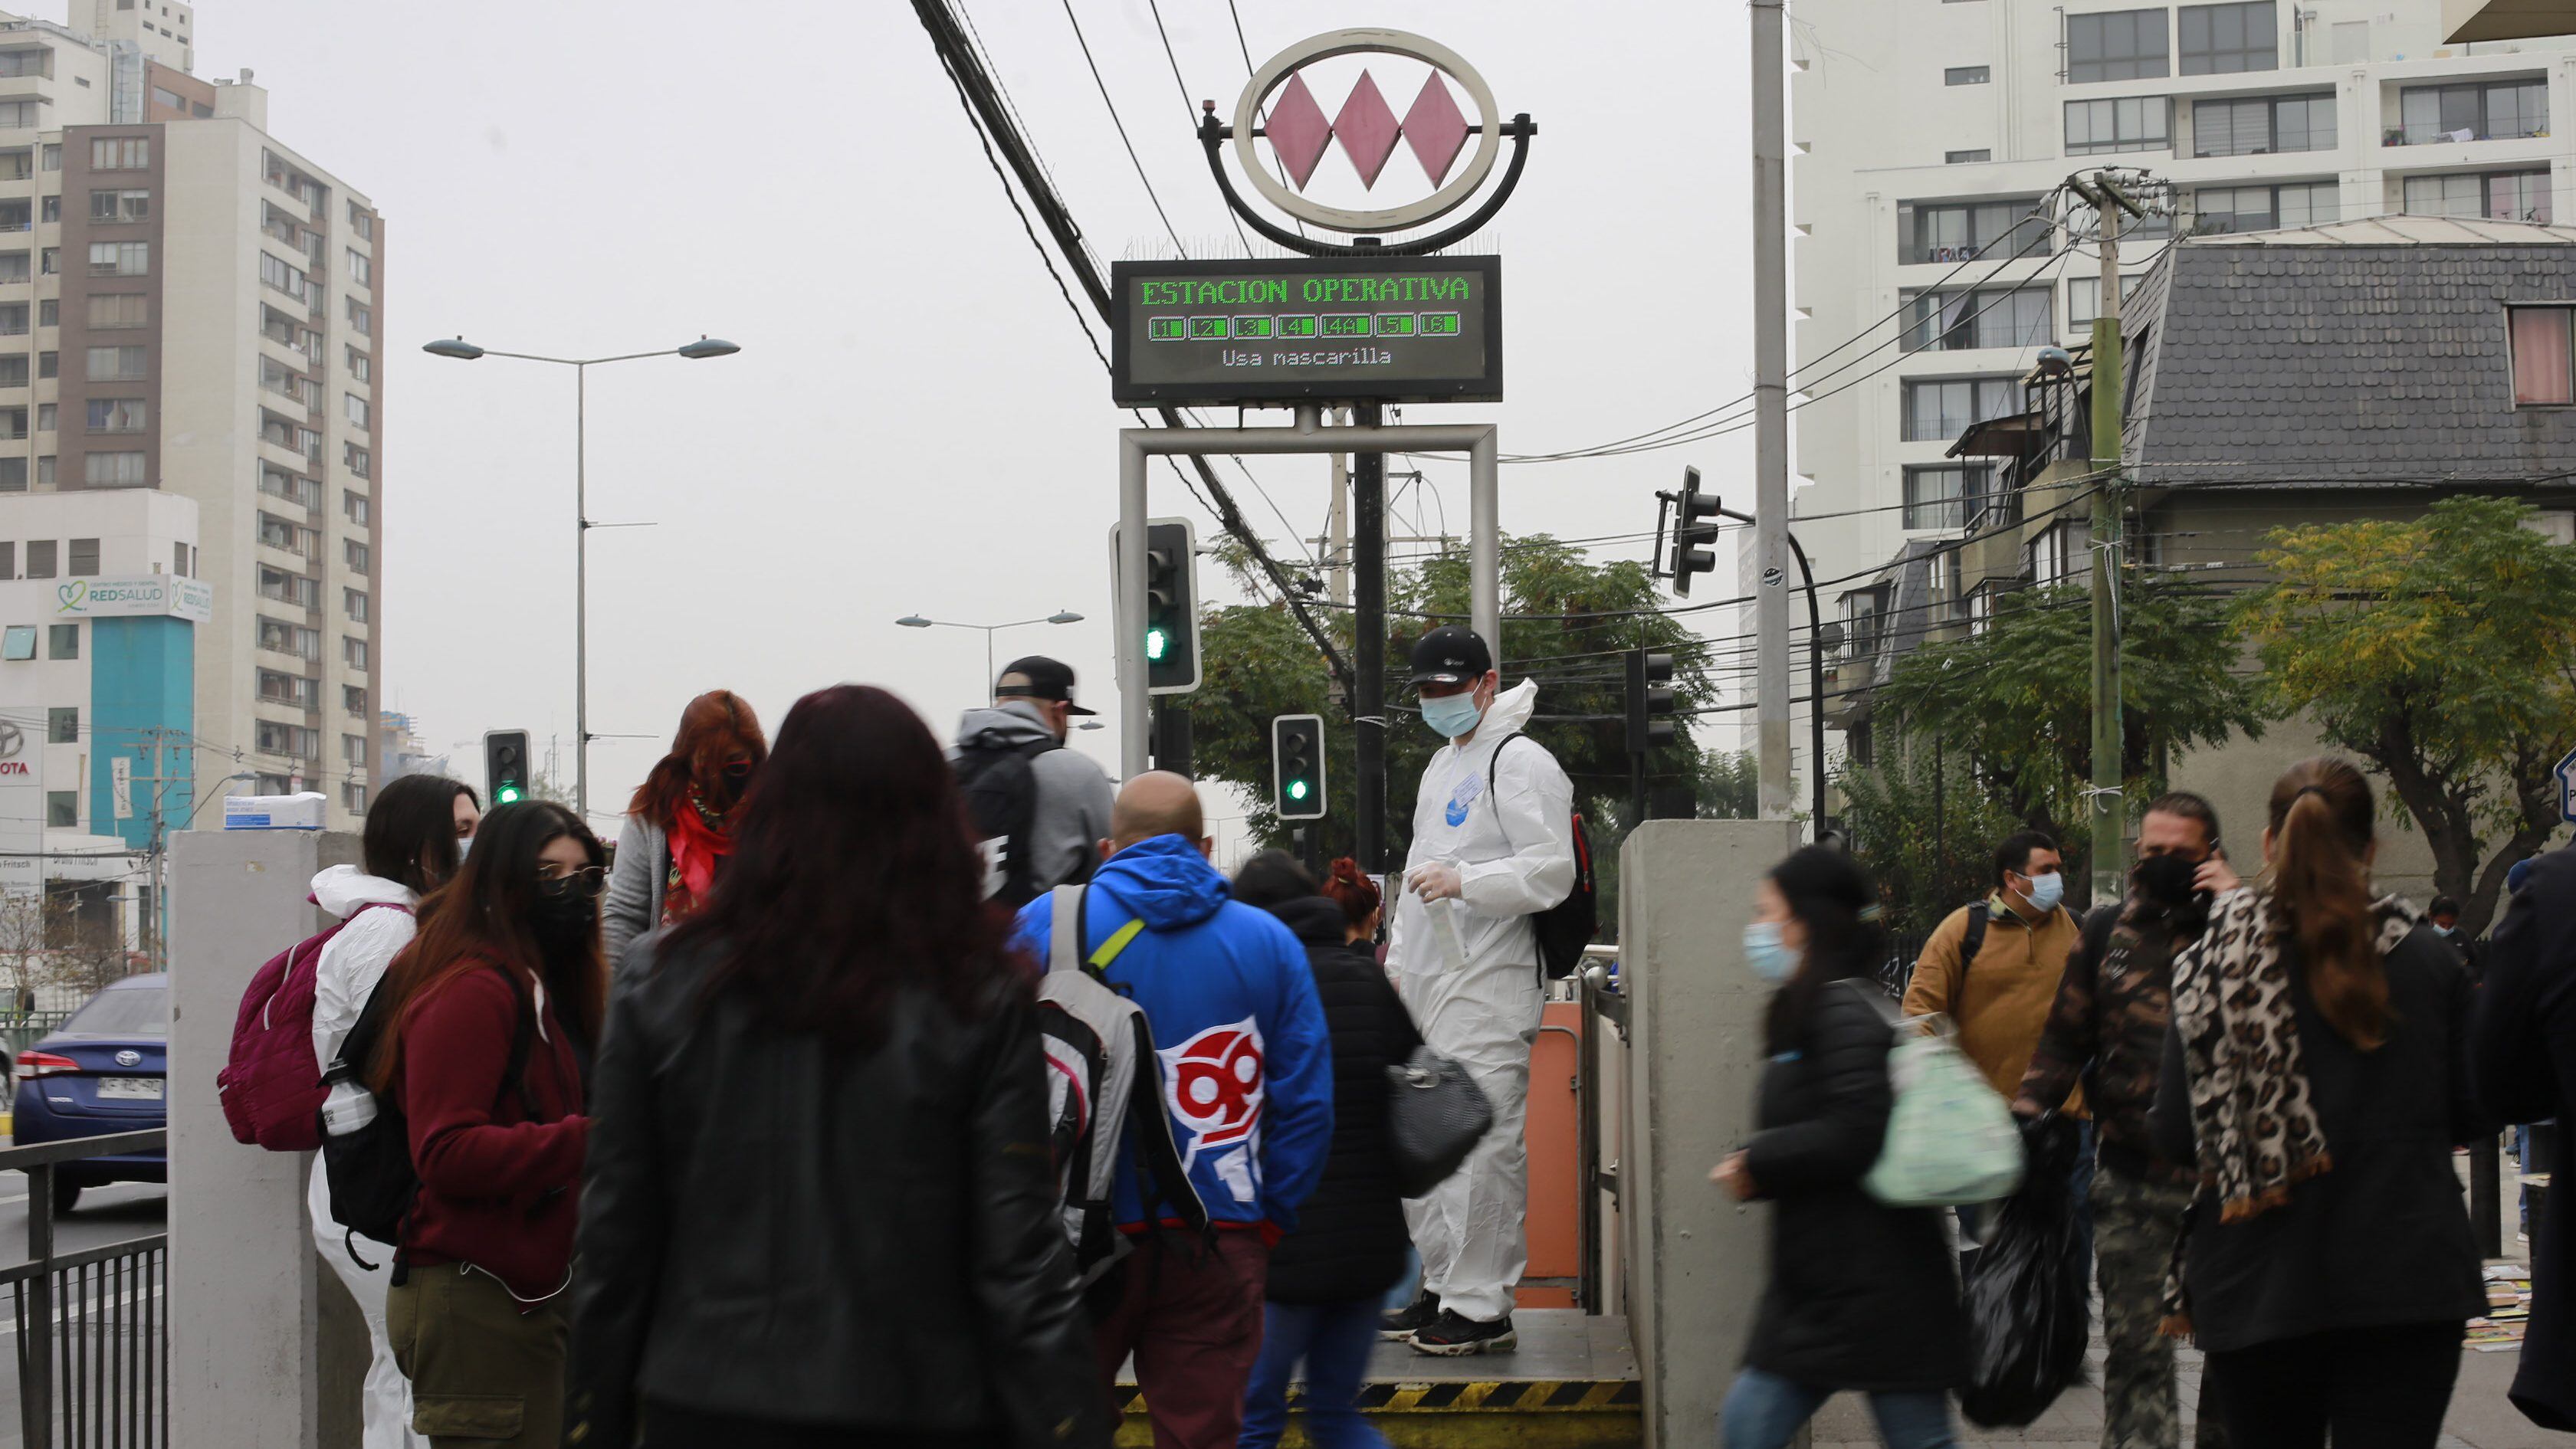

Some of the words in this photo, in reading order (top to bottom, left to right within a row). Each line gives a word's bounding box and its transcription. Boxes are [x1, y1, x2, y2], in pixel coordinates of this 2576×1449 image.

[1141, 279, 1288, 305] ESTACION
[1303, 277, 1470, 303] OPERATIVA
[1152, 320, 1170, 337] L1
[1192, 320, 1214, 336] L2
[1235, 319, 1258, 336] L3
[1279, 318, 1301, 335] L4
[1323, 317, 1356, 334] L4A
[1377, 316, 1400, 333] L5
[1421, 316, 1445, 333] L6
[1222, 349, 1263, 366] Usa
[1273, 347, 1392, 366] mascarilla
[90, 588, 163, 602] REDSALUD
[3, 860, 31, 868] Fritsch
